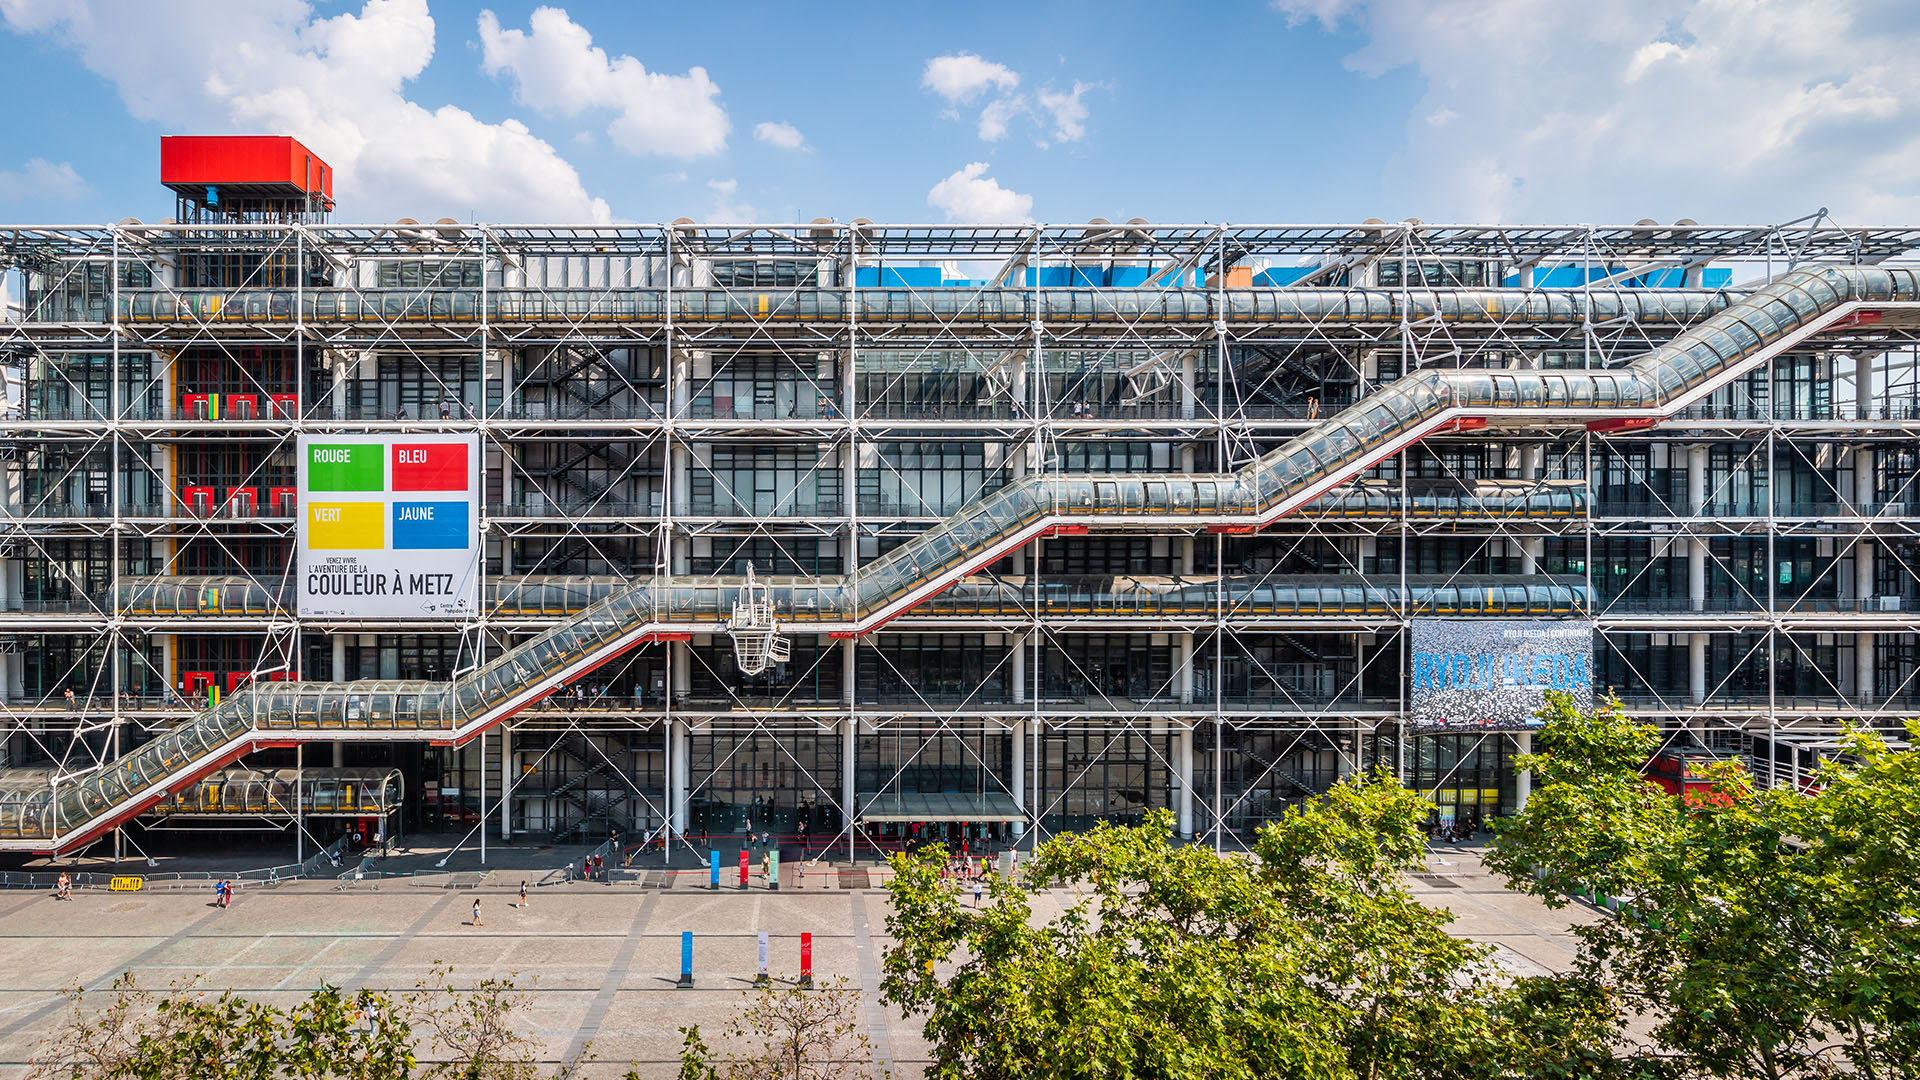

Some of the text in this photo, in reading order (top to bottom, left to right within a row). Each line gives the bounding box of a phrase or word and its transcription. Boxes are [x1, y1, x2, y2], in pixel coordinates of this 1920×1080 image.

[313, 449, 351, 463] ROUGE
[398, 449, 427, 463] BLEU
[314, 508, 342, 522] VERT
[398, 506, 434, 521] JAUNE
[308, 564, 368, 573] L'AVENTURE DE LA
[308, 569, 453, 595] COULEUR À METZ
[1415, 653, 1589, 691] RYOJI IKEDA
